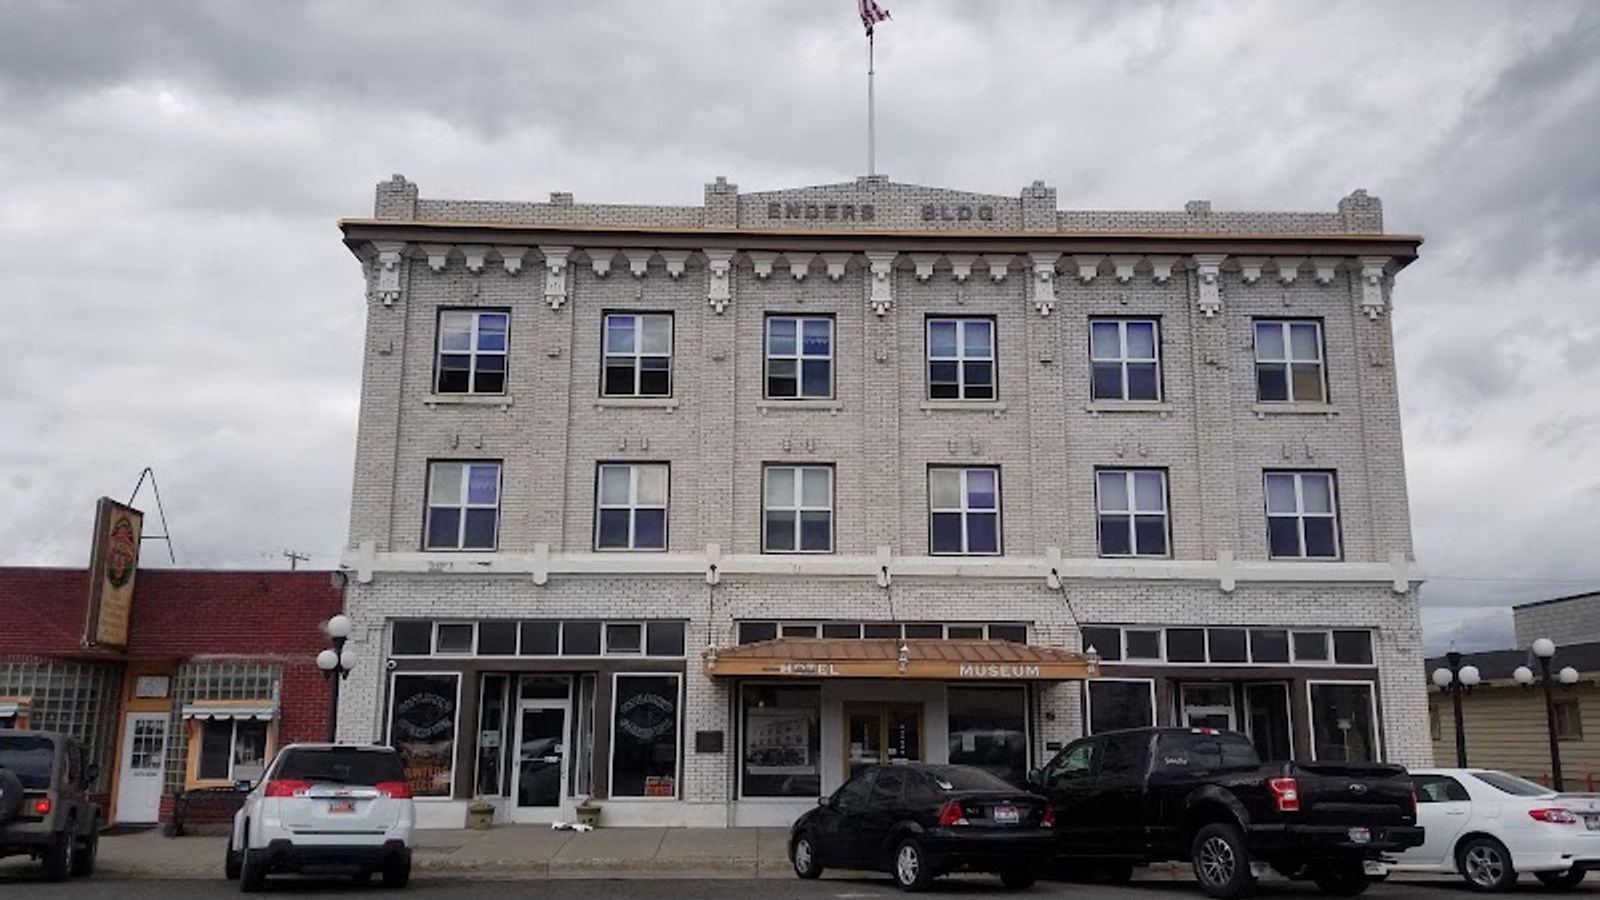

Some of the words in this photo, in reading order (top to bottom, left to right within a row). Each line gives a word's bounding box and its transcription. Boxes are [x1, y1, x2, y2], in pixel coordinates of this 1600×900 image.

[767, 203, 876, 221] ENDERS
[921, 205, 994, 221] BLDG
[782, 663, 840, 676] HOTEL
[960, 664, 1040, 678] MUSEUM
